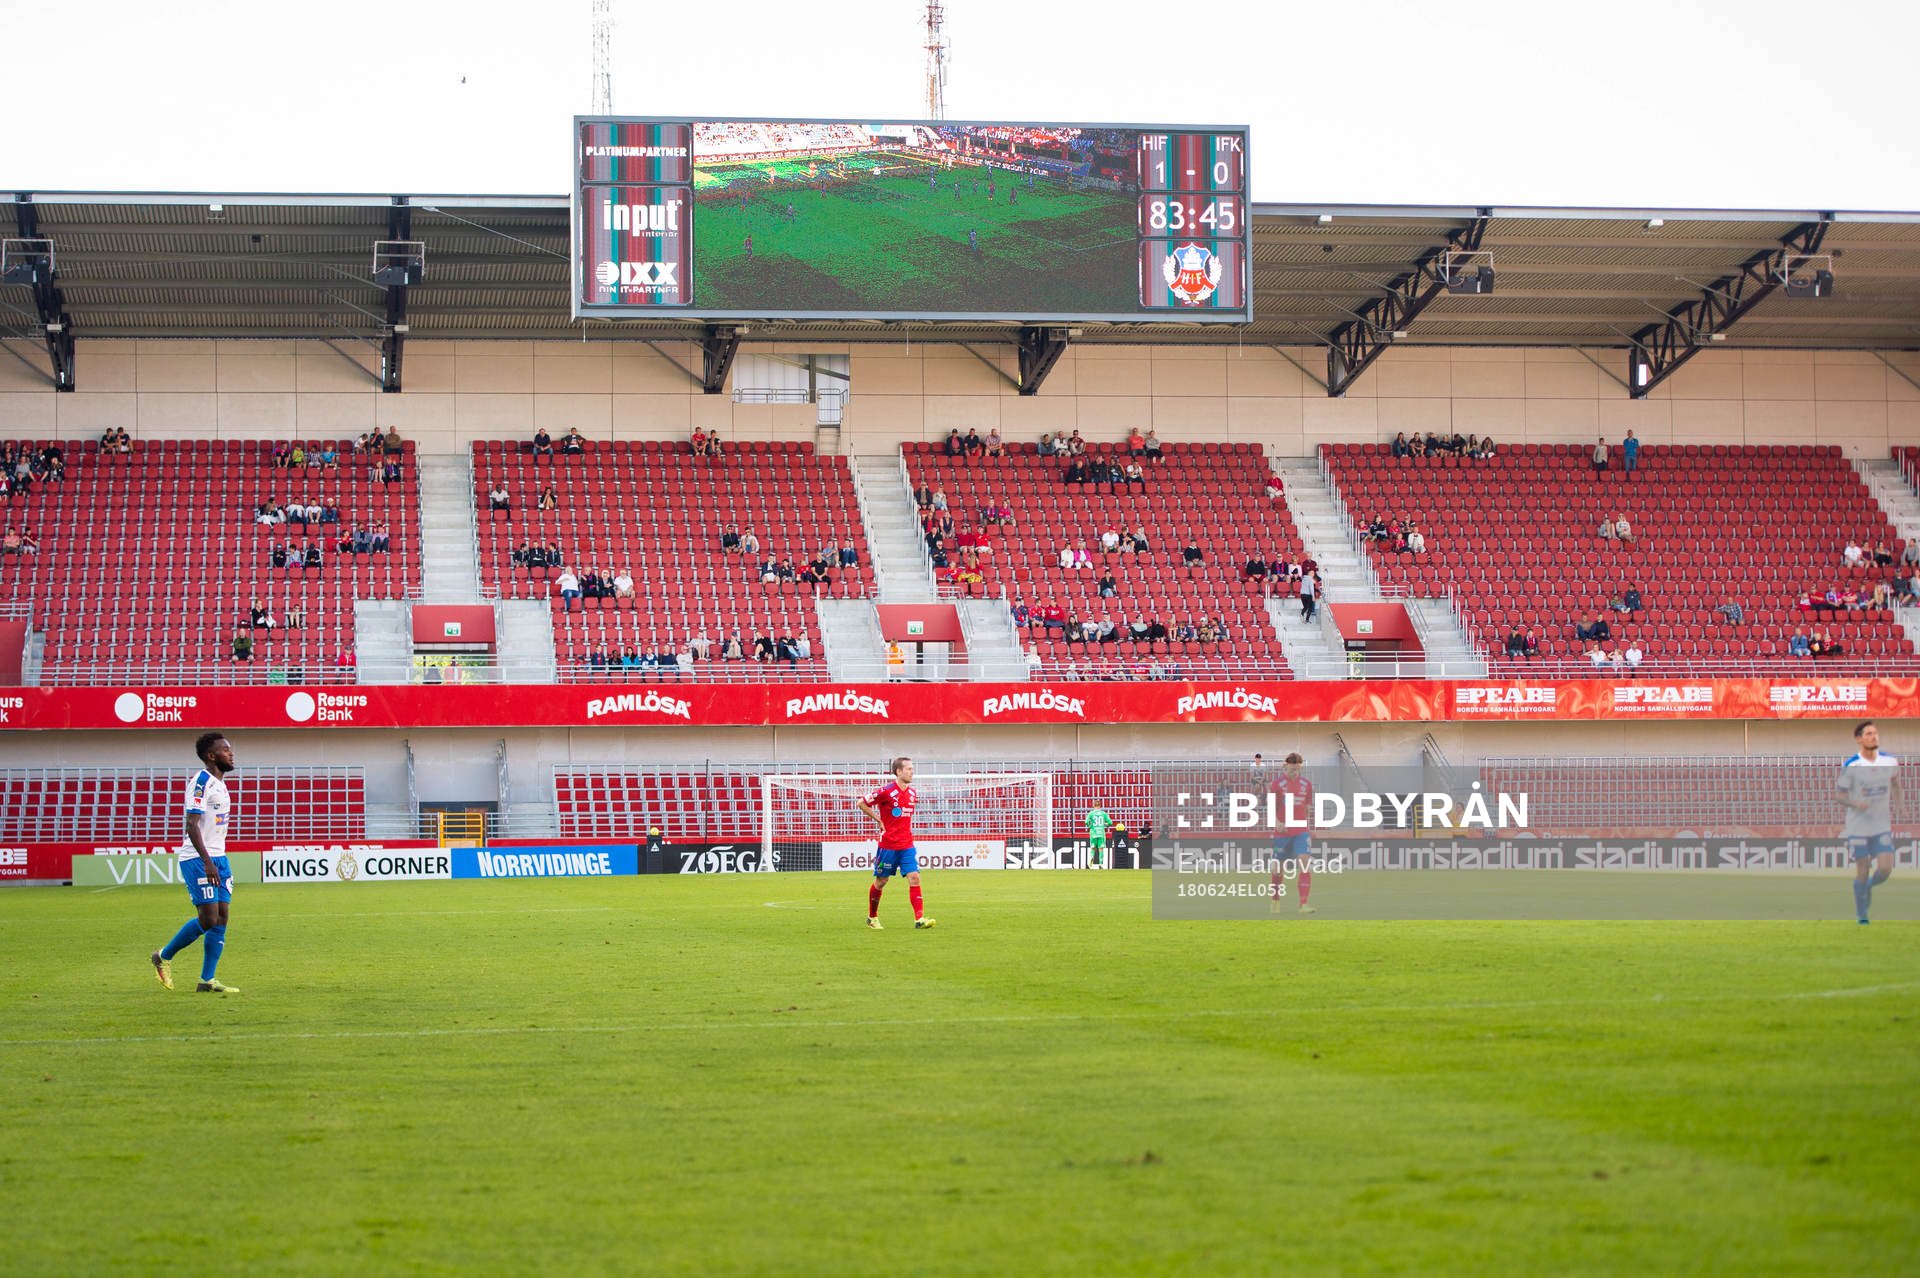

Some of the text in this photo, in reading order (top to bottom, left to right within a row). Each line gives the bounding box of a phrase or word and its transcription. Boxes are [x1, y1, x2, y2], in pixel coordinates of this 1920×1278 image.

[586, 146, 687, 157] PLATINUMPARTNER
[1142, 136, 1168, 150] HIF
[1216, 137, 1241, 152] IFK
[1155, 161, 1165, 184] 1
[1213, 162, 1228, 184] 0
[604, 200, 679, 237] input
[1150, 201, 1235, 230] 83:45
[147, 693, 197, 708] Resurs
[318, 692, 368, 707] Resurs
[983, 689, 1085, 717] RAMLÖSA
[1178, 688, 1278, 715] RAMLÖSA
[1466, 687, 1546, 703] PEAB
[1625, 687, 1702, 702] PEAB
[1781, 686, 1857, 702] PEAB
[587, 690, 692, 719] RAMLÖSA
[786, 689, 890, 719] RAMLÖSA
[147, 707, 183, 722] Bank
[318, 707, 353, 721] Bank
[1092, 815, 1104, 827] 30
[1434, 841, 1563, 869] stadium
[1575, 841, 1707, 868] stadium
[1719, 841, 1848, 868] stadium
[265, 856, 449, 877] KINGS CORNER
[477, 851, 612, 877] NORRVIDINGE
[201, 887, 214, 899] 10
